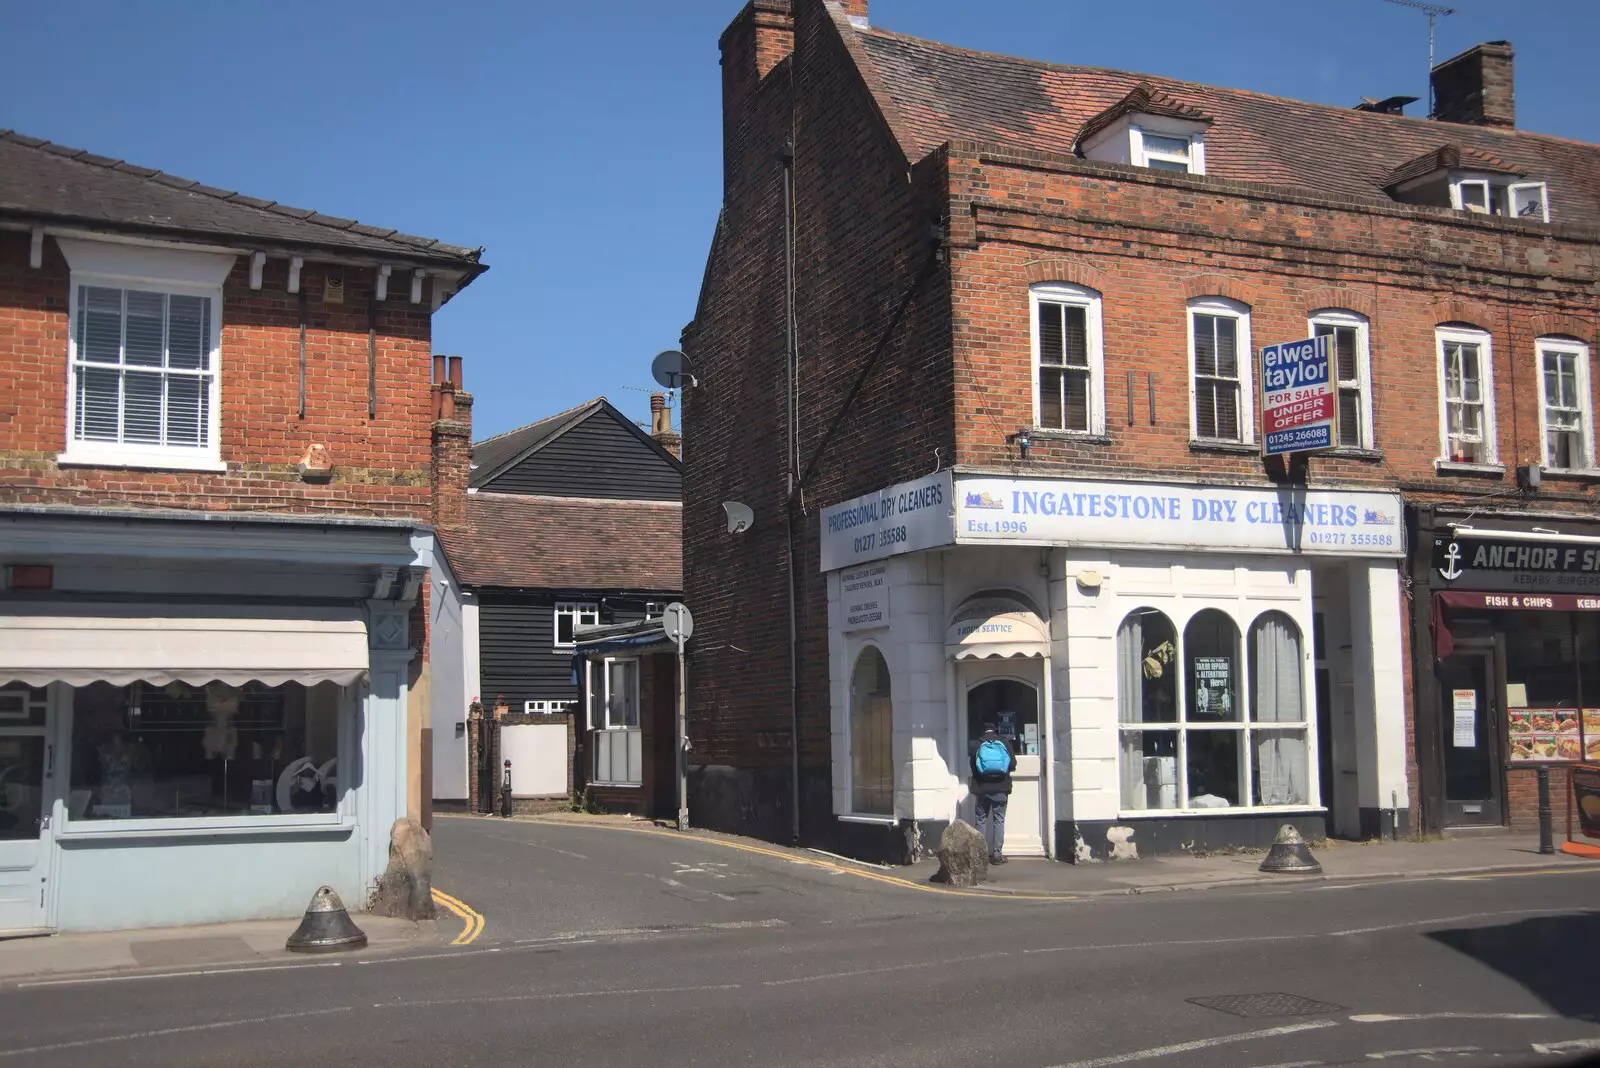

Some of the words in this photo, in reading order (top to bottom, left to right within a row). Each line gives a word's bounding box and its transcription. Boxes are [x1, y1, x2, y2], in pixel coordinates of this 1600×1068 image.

[1265, 336, 1326, 367] elwell
[1265, 361, 1327, 389] taylor
[1268, 393, 1291, 404] FOR
[1295, 387, 1325, 400] SALE
[1273, 398, 1324, 418] UNDER
[1274, 409, 1324, 428] OFFER
[1268, 432, 1294, 444] 01245
[1295, 428, 1327, 440] 266088
[1269, 438, 1327, 450] www.elwelltaylor.co.uk
[828, 502, 878, 534] PROFESSIONAL
[881, 496, 896, 519] DRY
[898, 484, 942, 514] CLEANERS
[1011, 490, 1180, 520] INGATESTONE
[1192, 498, 1237, 522] DRY
[1246, 501, 1358, 526] CLEANERS
[854, 534, 876, 553] 01277
[1310, 532, 1346, 544] 01277
[1350, 534, 1392, 546] 355588
[1472, 544, 1558, 570] ANCHOR
[1564, 550, 1577, 570] F
[1514, 574, 1550, 584] KEBABS
[1486, 596, 1508, 606] FISH
[1512, 596, 1518, 606] &
[1523, 597, 1552, 608] CHIPS
[982, 624, 1012, 632] SERVICE
